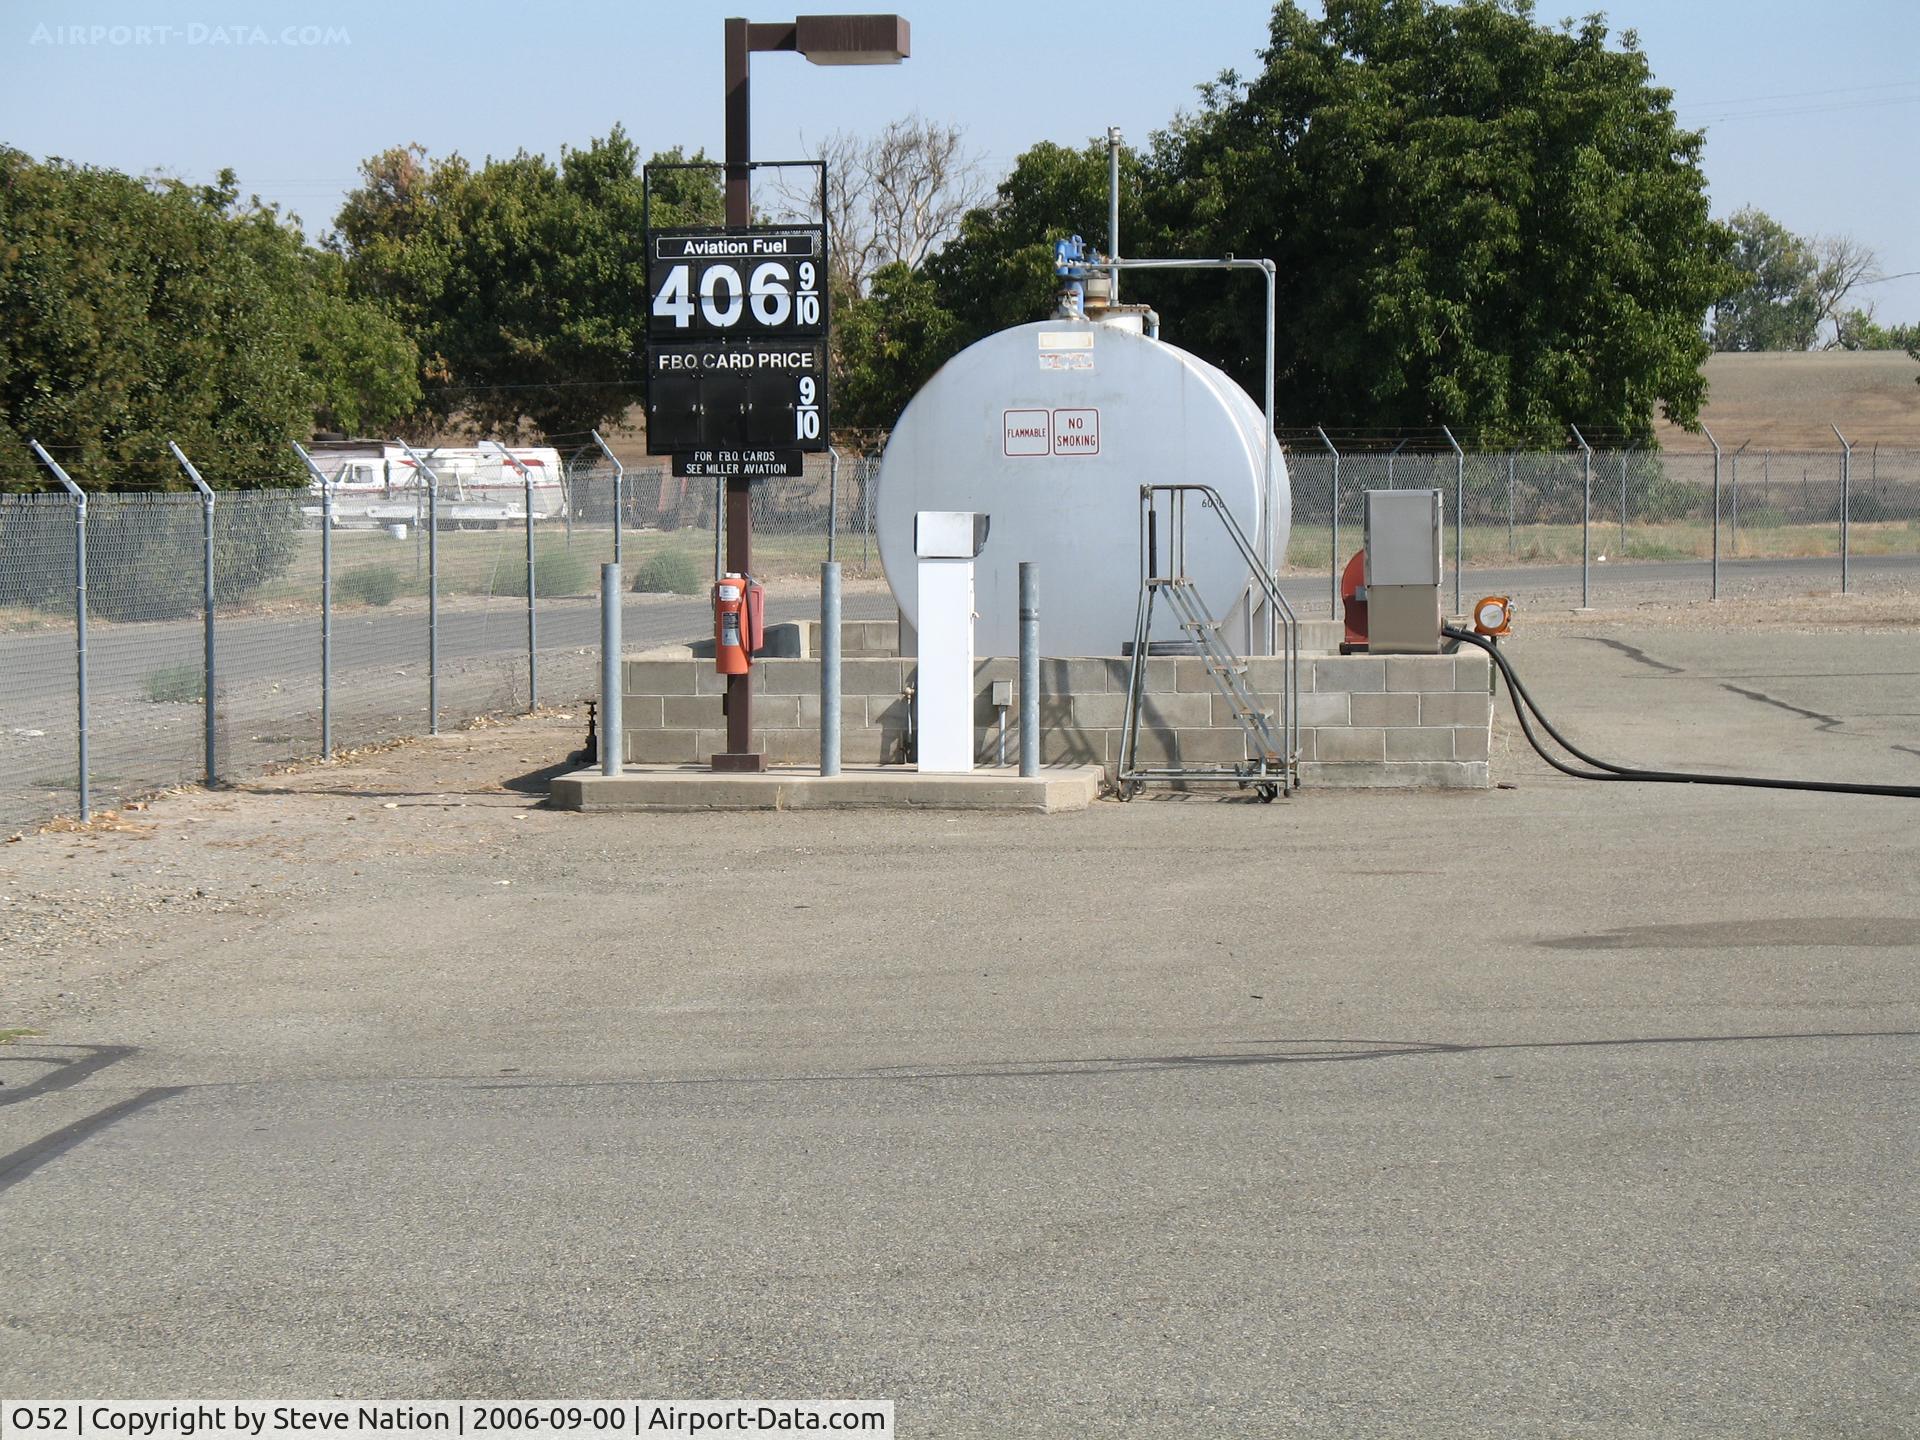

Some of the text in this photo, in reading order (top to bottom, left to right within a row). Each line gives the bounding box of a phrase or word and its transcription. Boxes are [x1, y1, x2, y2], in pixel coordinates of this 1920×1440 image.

[683, 238, 787, 255] Aviation Fuel
[799, 261, 816, 291] 9
[652, 261, 792, 328] 406
[796, 295, 820, 326] 10
[659, 352, 813, 370] F.B.O. CARD PRICE
[799, 376, 816, 405] 9
[796, 410, 820, 440] 10
[1068, 418, 1083, 429] NO
[1007, 428, 1046, 438] FLAMMABLE
[1056, 435, 1096, 447] SMOKING
[694, 451, 712, 462] FOR
[743, 451, 776, 462] CARDS
[686, 463, 787, 474] SEE MILLER AVIATION
